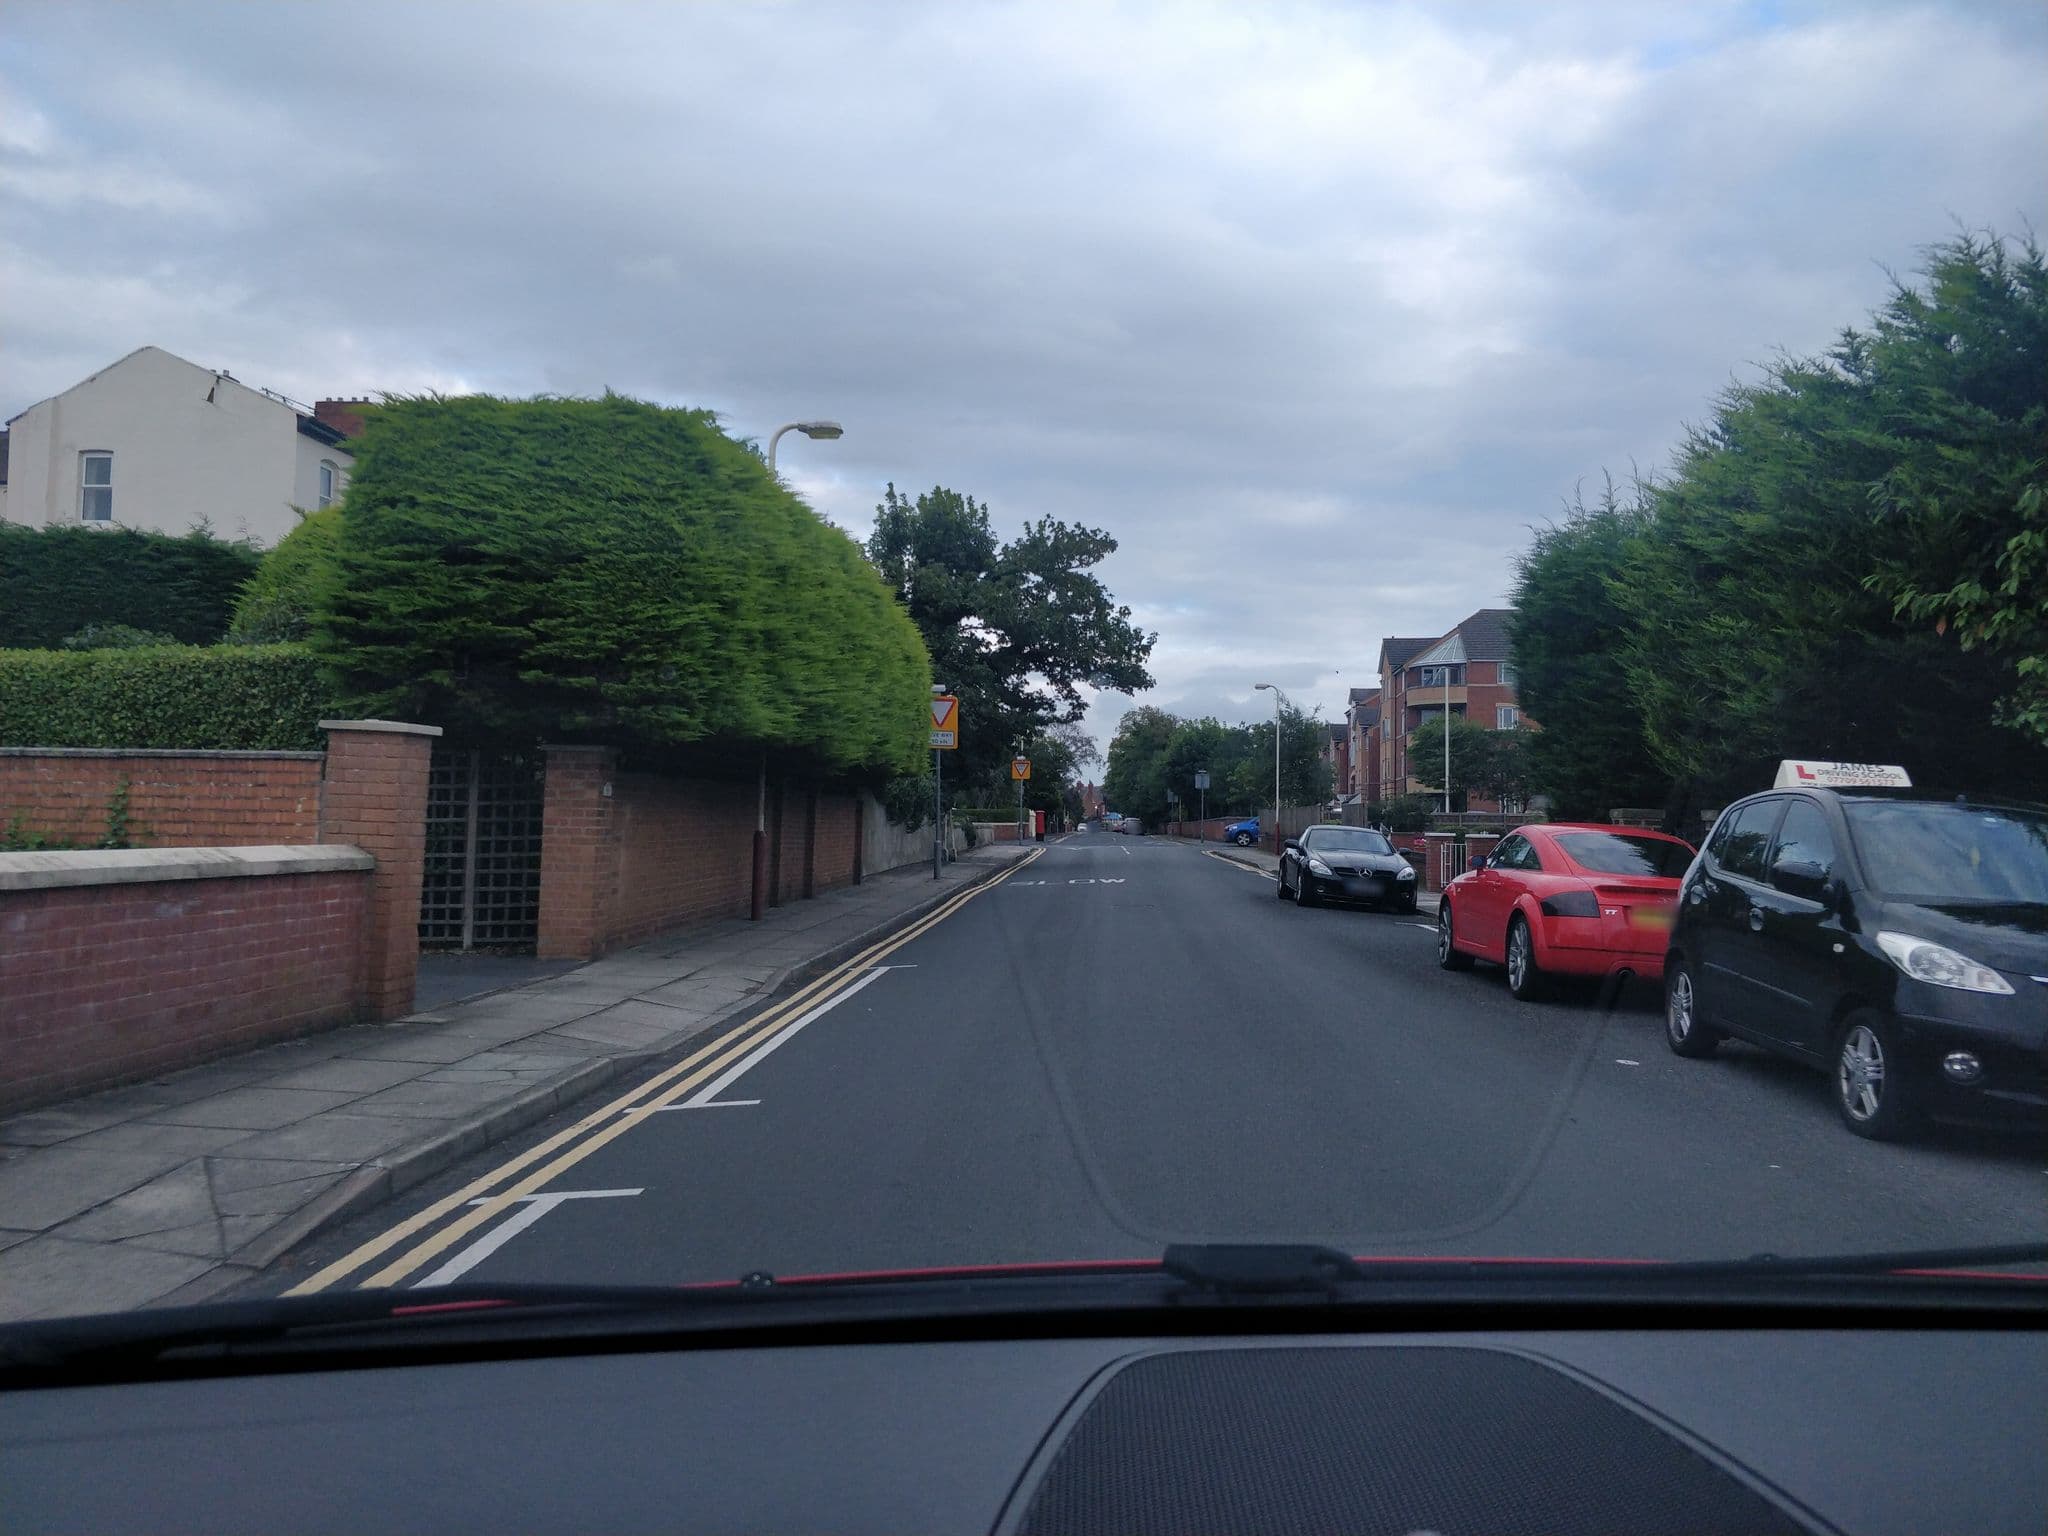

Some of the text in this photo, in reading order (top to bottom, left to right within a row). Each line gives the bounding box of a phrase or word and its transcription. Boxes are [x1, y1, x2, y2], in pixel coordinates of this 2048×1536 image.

[1795, 765, 1816, 780] L
[1832, 763, 1884, 772] JAMES
[1817, 769, 1904, 780] DRIVING SCHOOL
